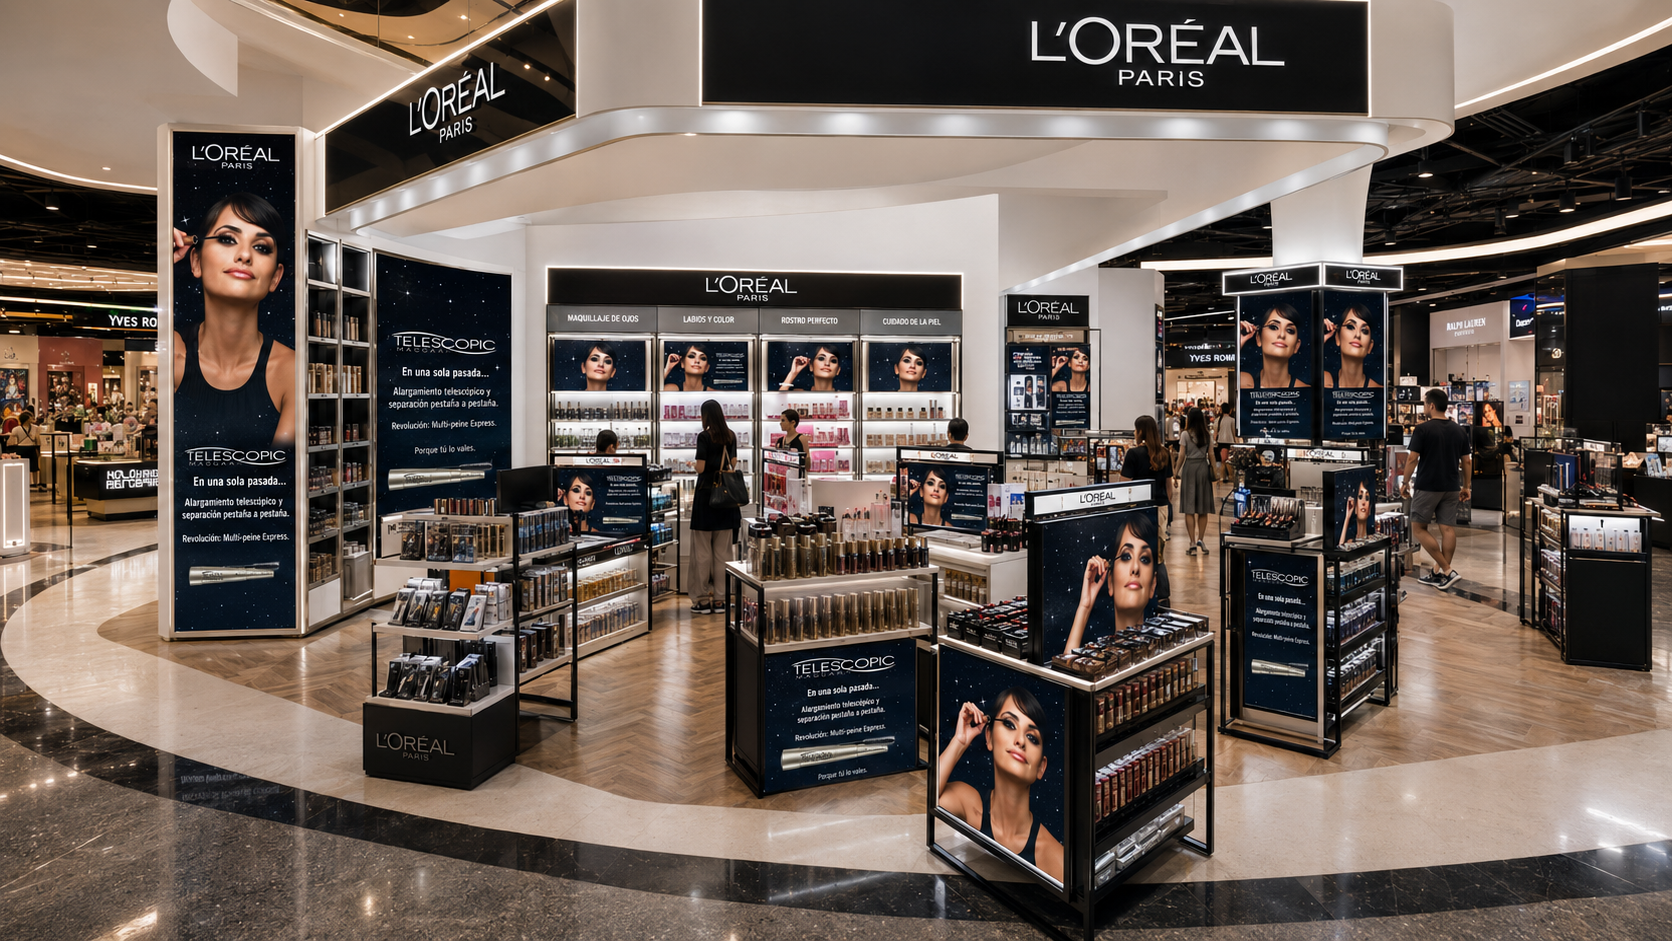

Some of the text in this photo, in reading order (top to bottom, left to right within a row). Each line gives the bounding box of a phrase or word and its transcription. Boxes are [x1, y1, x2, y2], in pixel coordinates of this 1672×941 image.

[1031, 16, 1285, 66] L'ORÉAL
[1118, 69, 1204, 88] PARIS
[409, 62, 506, 136] L'ORÉAL
[439, 116, 473, 144] PARIS
[192, 144, 280, 162] L'ORÉAL
[221, 162, 253, 170] PARIS
[705, 275, 798, 294] L'ORÉAL
[736, 294, 768, 302] PARIS
[1018, 300, 1079, 314] L'ORÉAL
[108, 315, 138, 328] YVES
[567, 314, 639, 322] MAQUILLAJE DE OJOS
[713, 316, 734, 324] COLOR
[392, 333, 496, 353] TELESCOPIC
[1189, 354, 1211, 362] YVES
[402, 367, 489, 379] En una sola pasada...
[393, 387, 442, 398] Alargamiento
[449, 445, 455, 453] lo
[186, 448, 286, 464] TELESCOPIC
[194, 476, 287, 488] En una sola pasada...
[184, 498, 234, 509] Alargamiento
[182, 510, 221, 520] separación
[1252, 570, 1309, 585] TELESCOPIC
[792, 655, 896, 675] TELESCOPIC
[807, 689, 816, 697] En
[833, 685, 847, 694] sola
[376, 732, 455, 756] L'ORÉAL
[402, 751, 429, 762] PARIS
